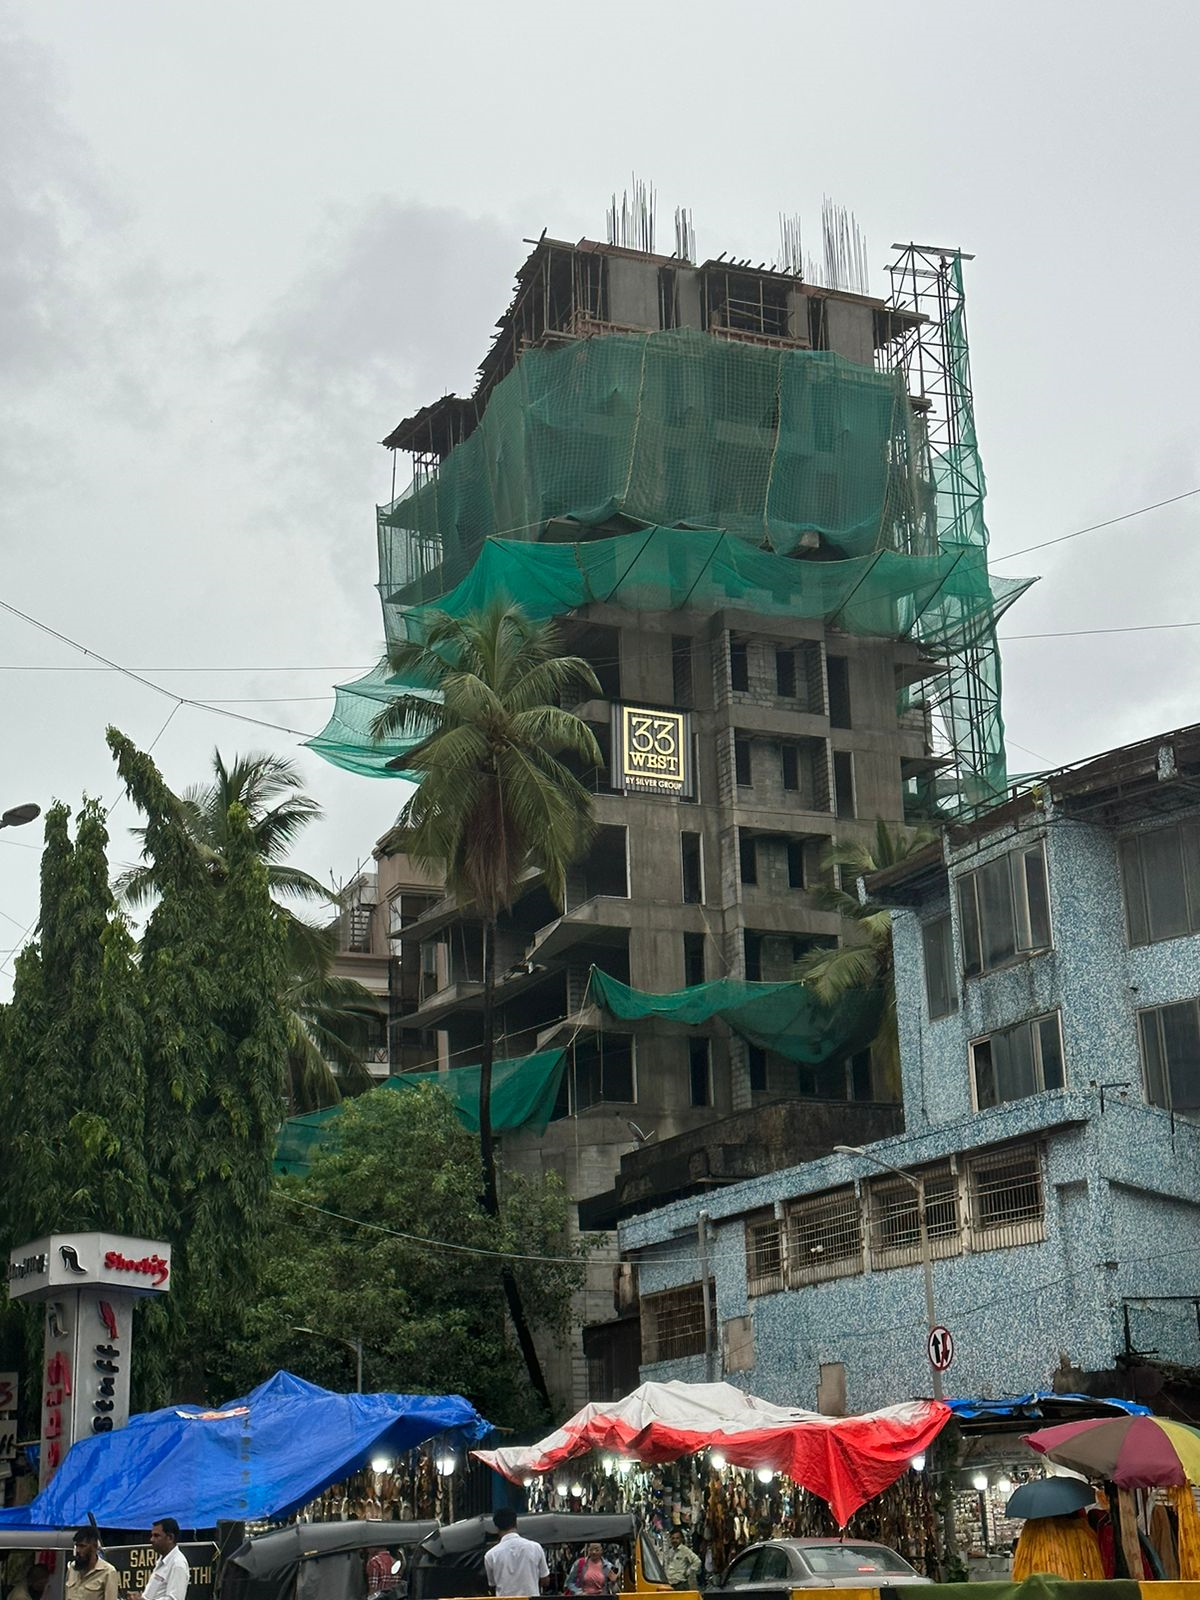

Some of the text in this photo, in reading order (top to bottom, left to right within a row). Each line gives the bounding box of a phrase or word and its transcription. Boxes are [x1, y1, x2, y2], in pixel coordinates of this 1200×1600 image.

[632, 716, 675, 755] 33
[629, 751, 678, 771] WEST
[625, 776, 682, 790] BY SILVER GROUP
[117, 1570, 131, 1589] AR
